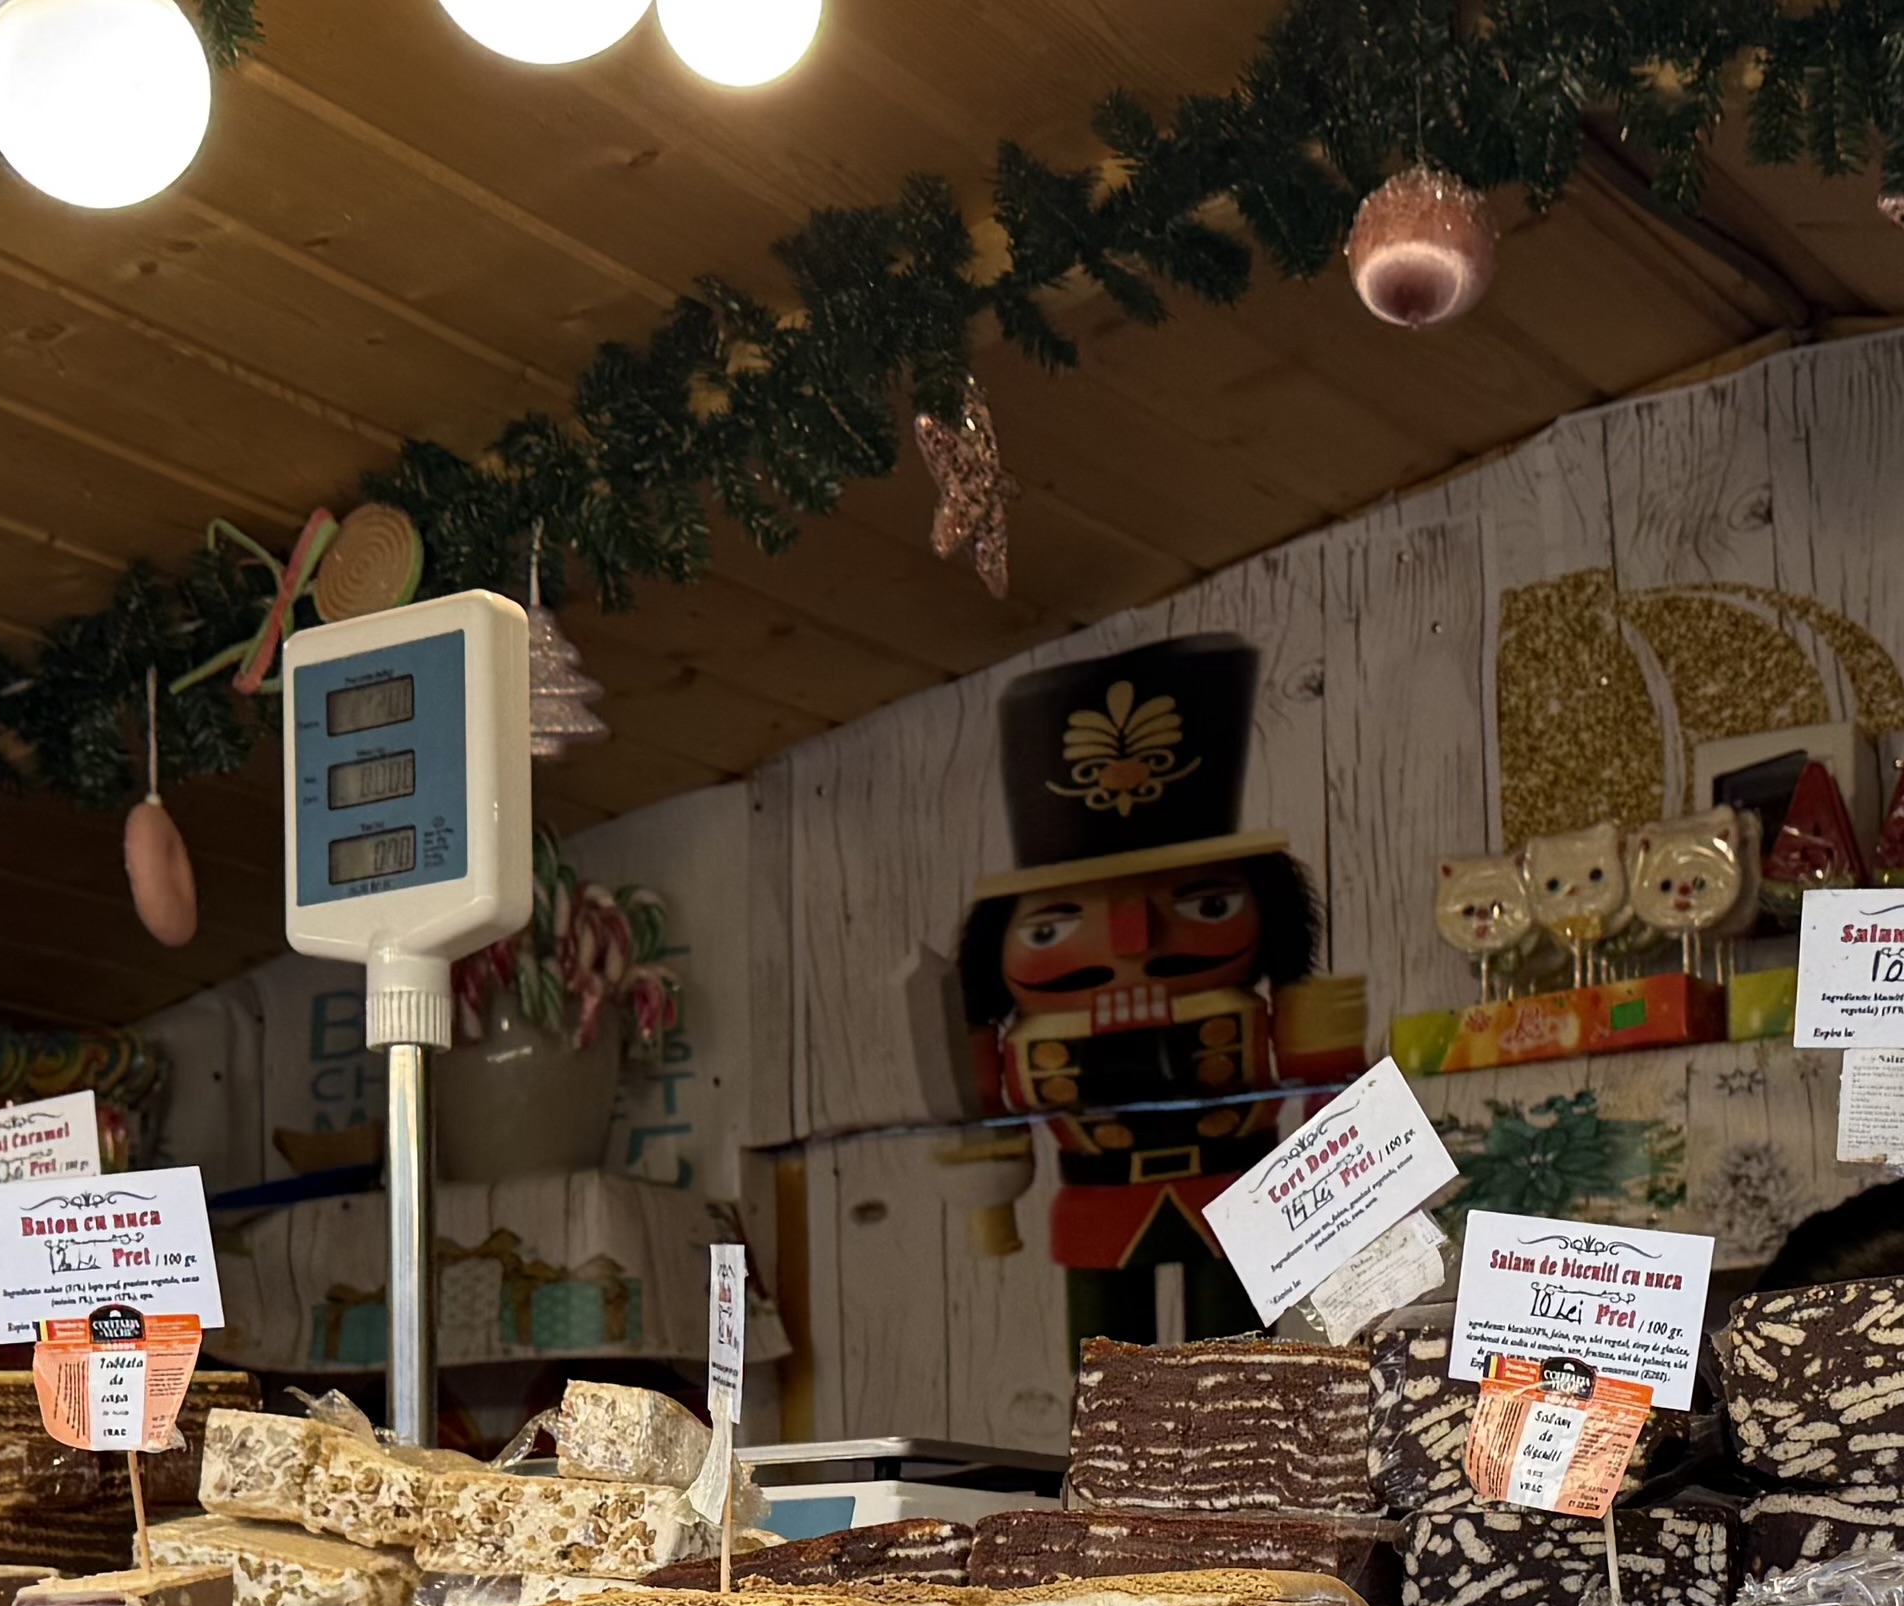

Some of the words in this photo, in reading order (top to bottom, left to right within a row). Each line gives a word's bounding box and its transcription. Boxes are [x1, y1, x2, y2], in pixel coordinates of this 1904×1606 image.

[12, 1121, 70, 1149] Caramel
[1305, 1125, 1360, 1174] Dobos
[1338, 1149, 1376, 1189] Pret
[1385, 1135, 1402, 1157] 100
[30, 1158, 57, 1177] Pret
[21, 1215, 79, 1236] Baton
[84, 1214, 107, 1232] cu
[113, 1210, 162, 1228] nuca
[112, 1247, 151, 1268] Pret
[163, 1253, 181, 1266] 100
[1490, 1250, 1535, 1273] Salam
[1539, 1255, 1557, 1276] de
[1561, 1257, 1618, 1284] biscuiti
[1622, 1270, 1640, 1286] cu
[1644, 1272, 1683, 1290] nuca
[1595, 1303, 1637, 1329] Pret
[1647, 1320, 1668, 1336] 100
[1535, 1410, 1571, 1429] Salam
[1538, 1429, 1553, 1442] de
